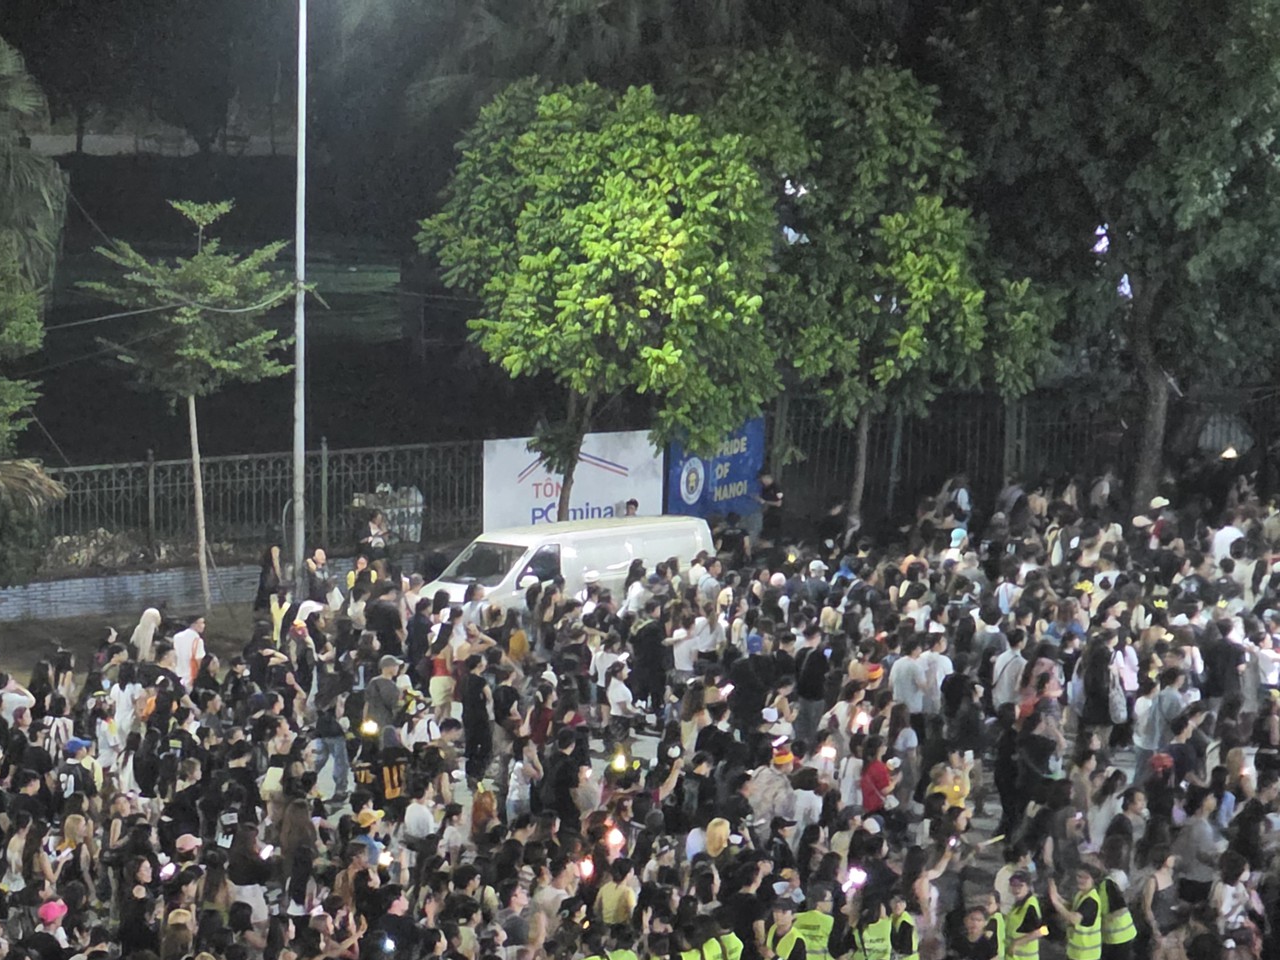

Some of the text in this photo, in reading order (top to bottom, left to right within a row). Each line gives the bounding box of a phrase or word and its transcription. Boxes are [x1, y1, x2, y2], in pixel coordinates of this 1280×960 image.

[716, 436, 748, 458] PRIDE
[715, 462, 731, 480] OF
[714, 480, 748, 502] HANOI
